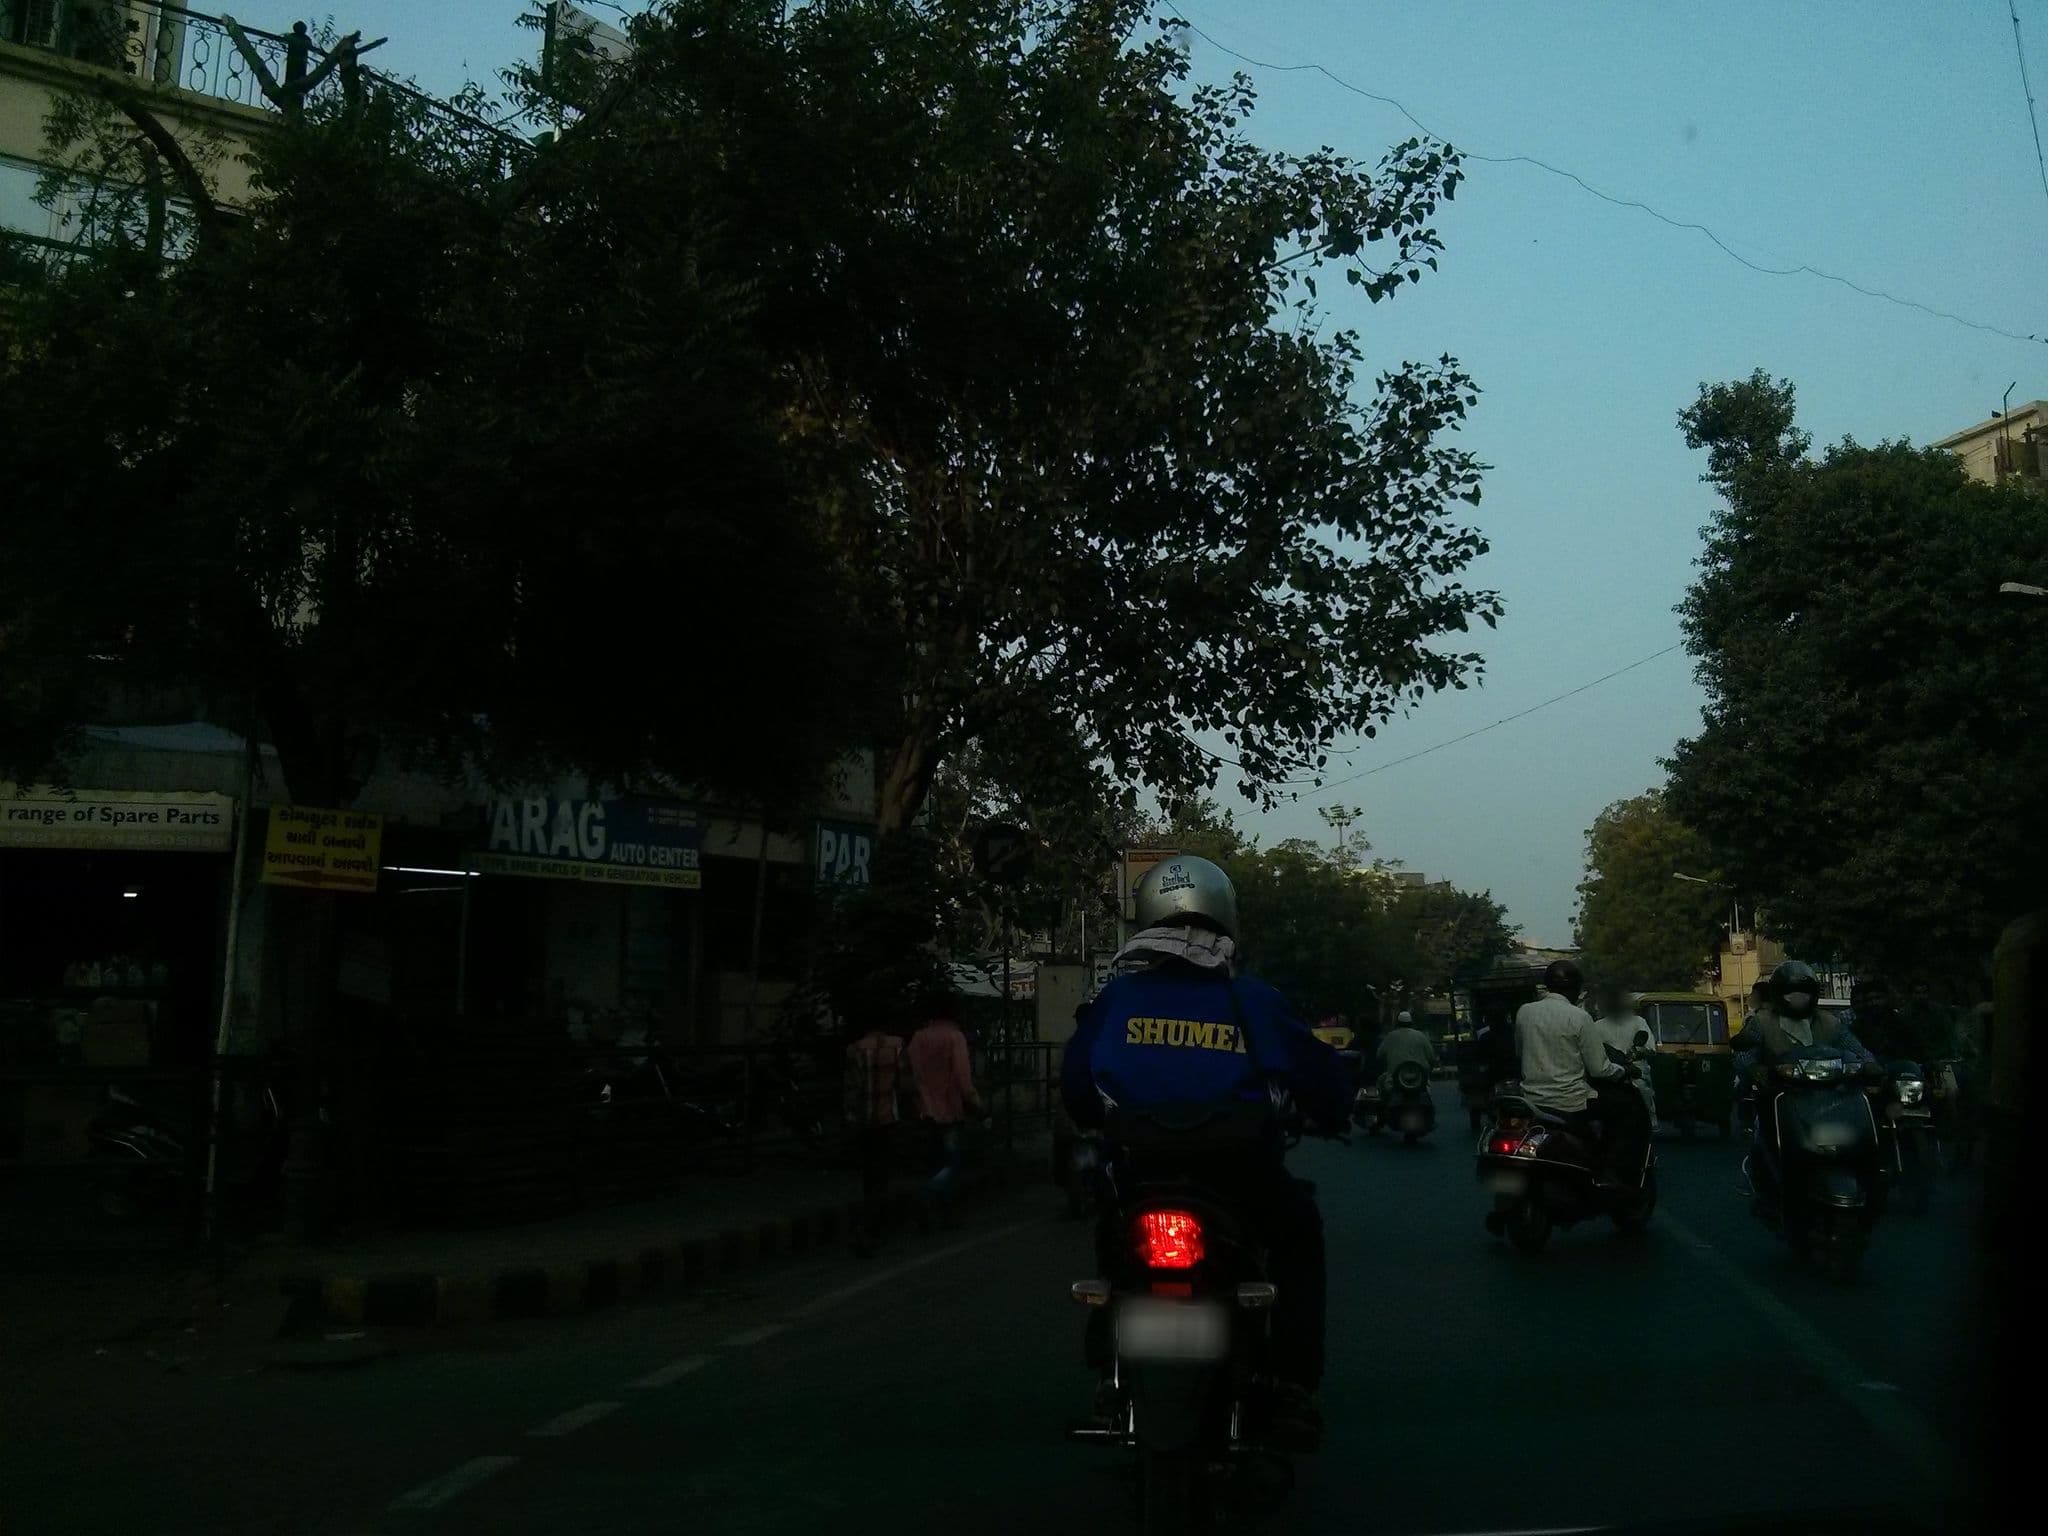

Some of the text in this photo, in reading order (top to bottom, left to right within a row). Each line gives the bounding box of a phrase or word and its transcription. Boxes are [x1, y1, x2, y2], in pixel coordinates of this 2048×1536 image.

[8, 807, 220, 826] range of Spare Parts
[486, 796, 606, 860] ARAG
[609, 841, 700, 868] AUTO CENTER
[820, 829, 870, 885] PAR
